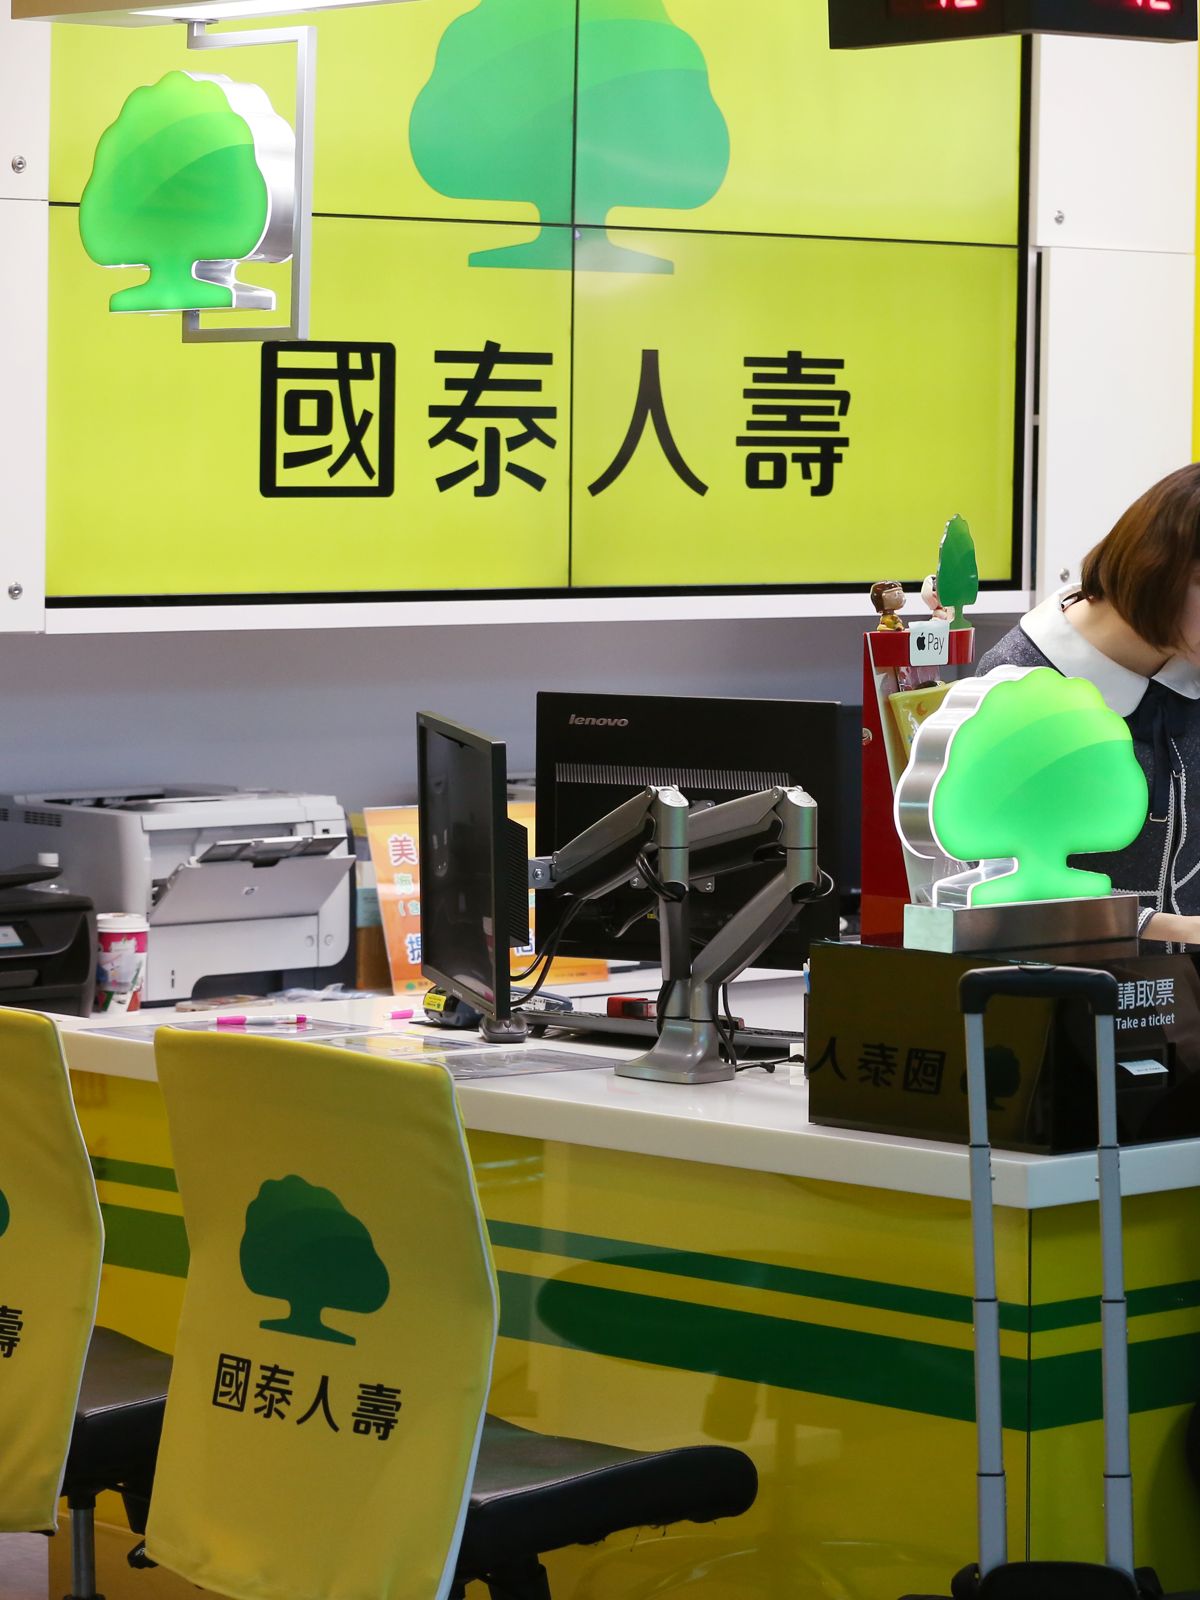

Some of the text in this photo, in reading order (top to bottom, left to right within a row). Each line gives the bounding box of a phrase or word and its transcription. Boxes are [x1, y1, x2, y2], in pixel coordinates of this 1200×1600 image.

[260, 340, 850, 498] 國泰人壽
[927, 632, 945, 655] Pay
[568, 714, 629, 727] lenovo
[1117, 978, 1175, 1011] 請取票
[1115, 1012, 1175, 1030] Take a ticket
[212, 1353, 402, 1441] 國泰人壽
